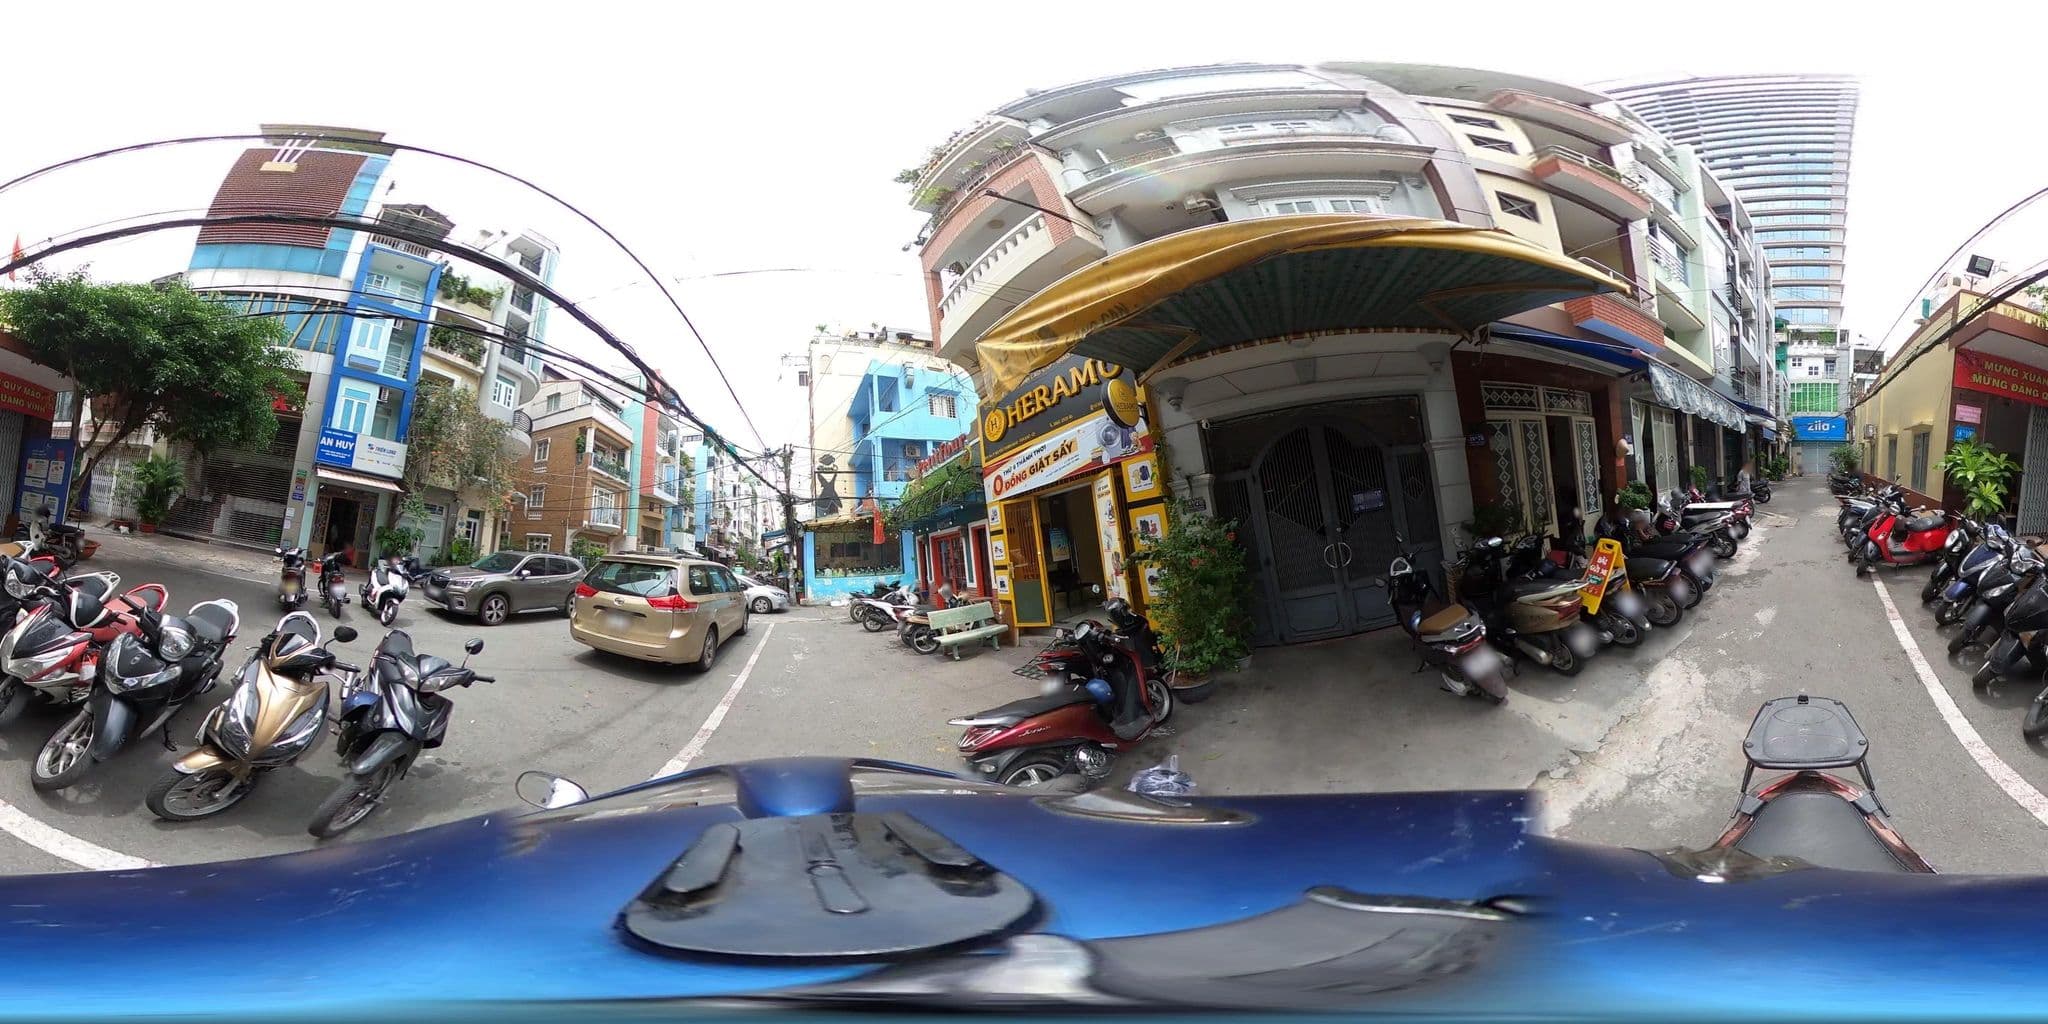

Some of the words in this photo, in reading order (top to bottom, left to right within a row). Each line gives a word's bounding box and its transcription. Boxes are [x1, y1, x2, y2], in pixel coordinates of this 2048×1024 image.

[1006, 357, 1124, 428] HERAMO
[319, 436, 334, 447] AN
[335, 439, 355, 451] HUY
[1028, 455, 1051, 475] GIẶT
[1052, 439, 1074, 462] SẤY
